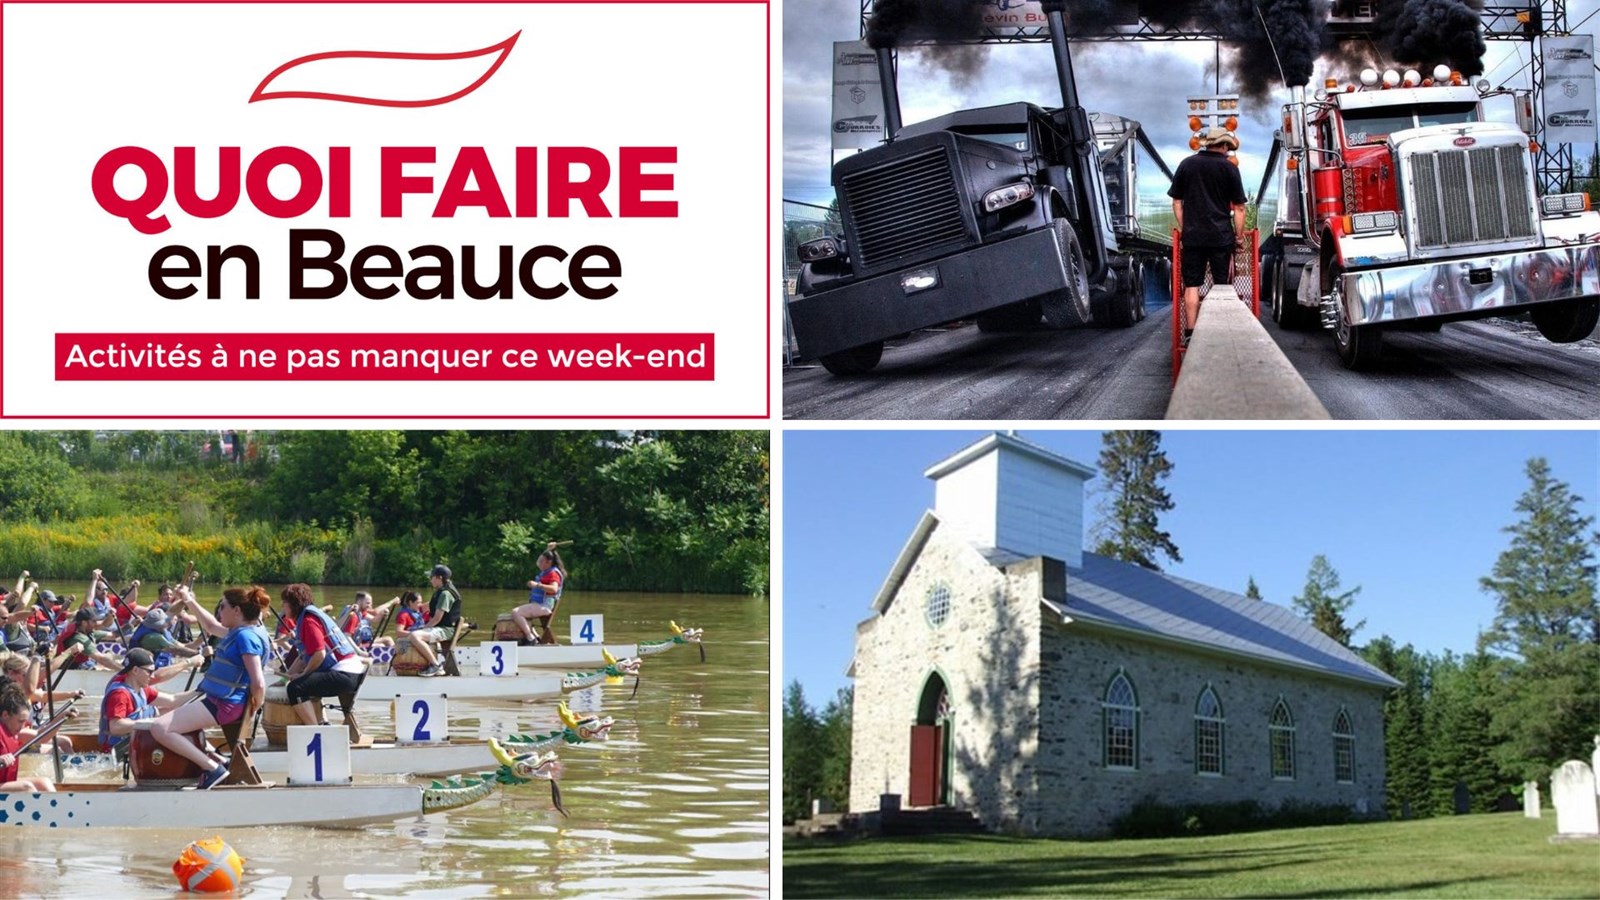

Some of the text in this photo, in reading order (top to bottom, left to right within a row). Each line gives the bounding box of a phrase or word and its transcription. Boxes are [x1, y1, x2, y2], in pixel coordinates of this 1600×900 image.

[980, 13, 1019, 23] evin
[579, 618, 595, 642] 4
[491, 645, 504, 675] 3
[412, 700, 431, 740] 2
[307, 733, 323, 782] 1
